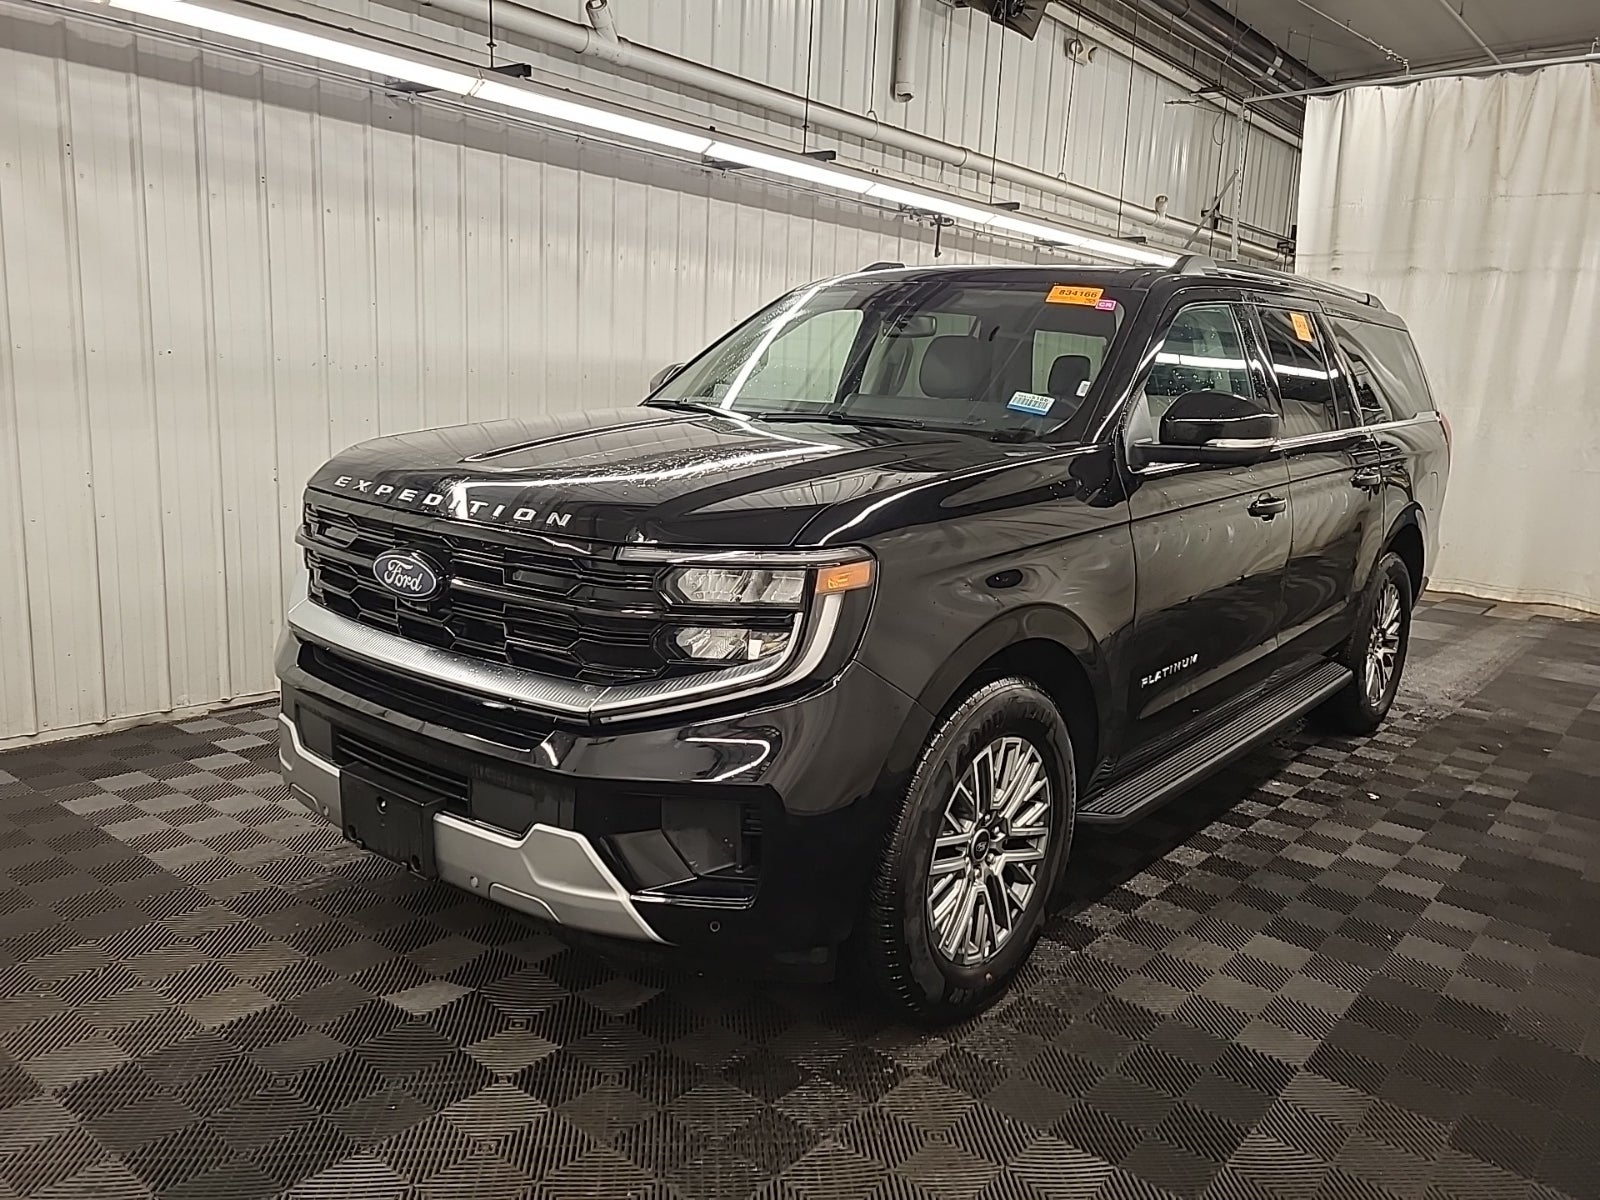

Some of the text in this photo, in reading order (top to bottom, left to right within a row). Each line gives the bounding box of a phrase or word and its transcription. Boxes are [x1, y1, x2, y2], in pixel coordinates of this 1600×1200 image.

[334, 475, 572, 527] EXPEDITION
[383, 559, 424, 592] Ford
[1141, 653, 1199, 688] PLATINUM
